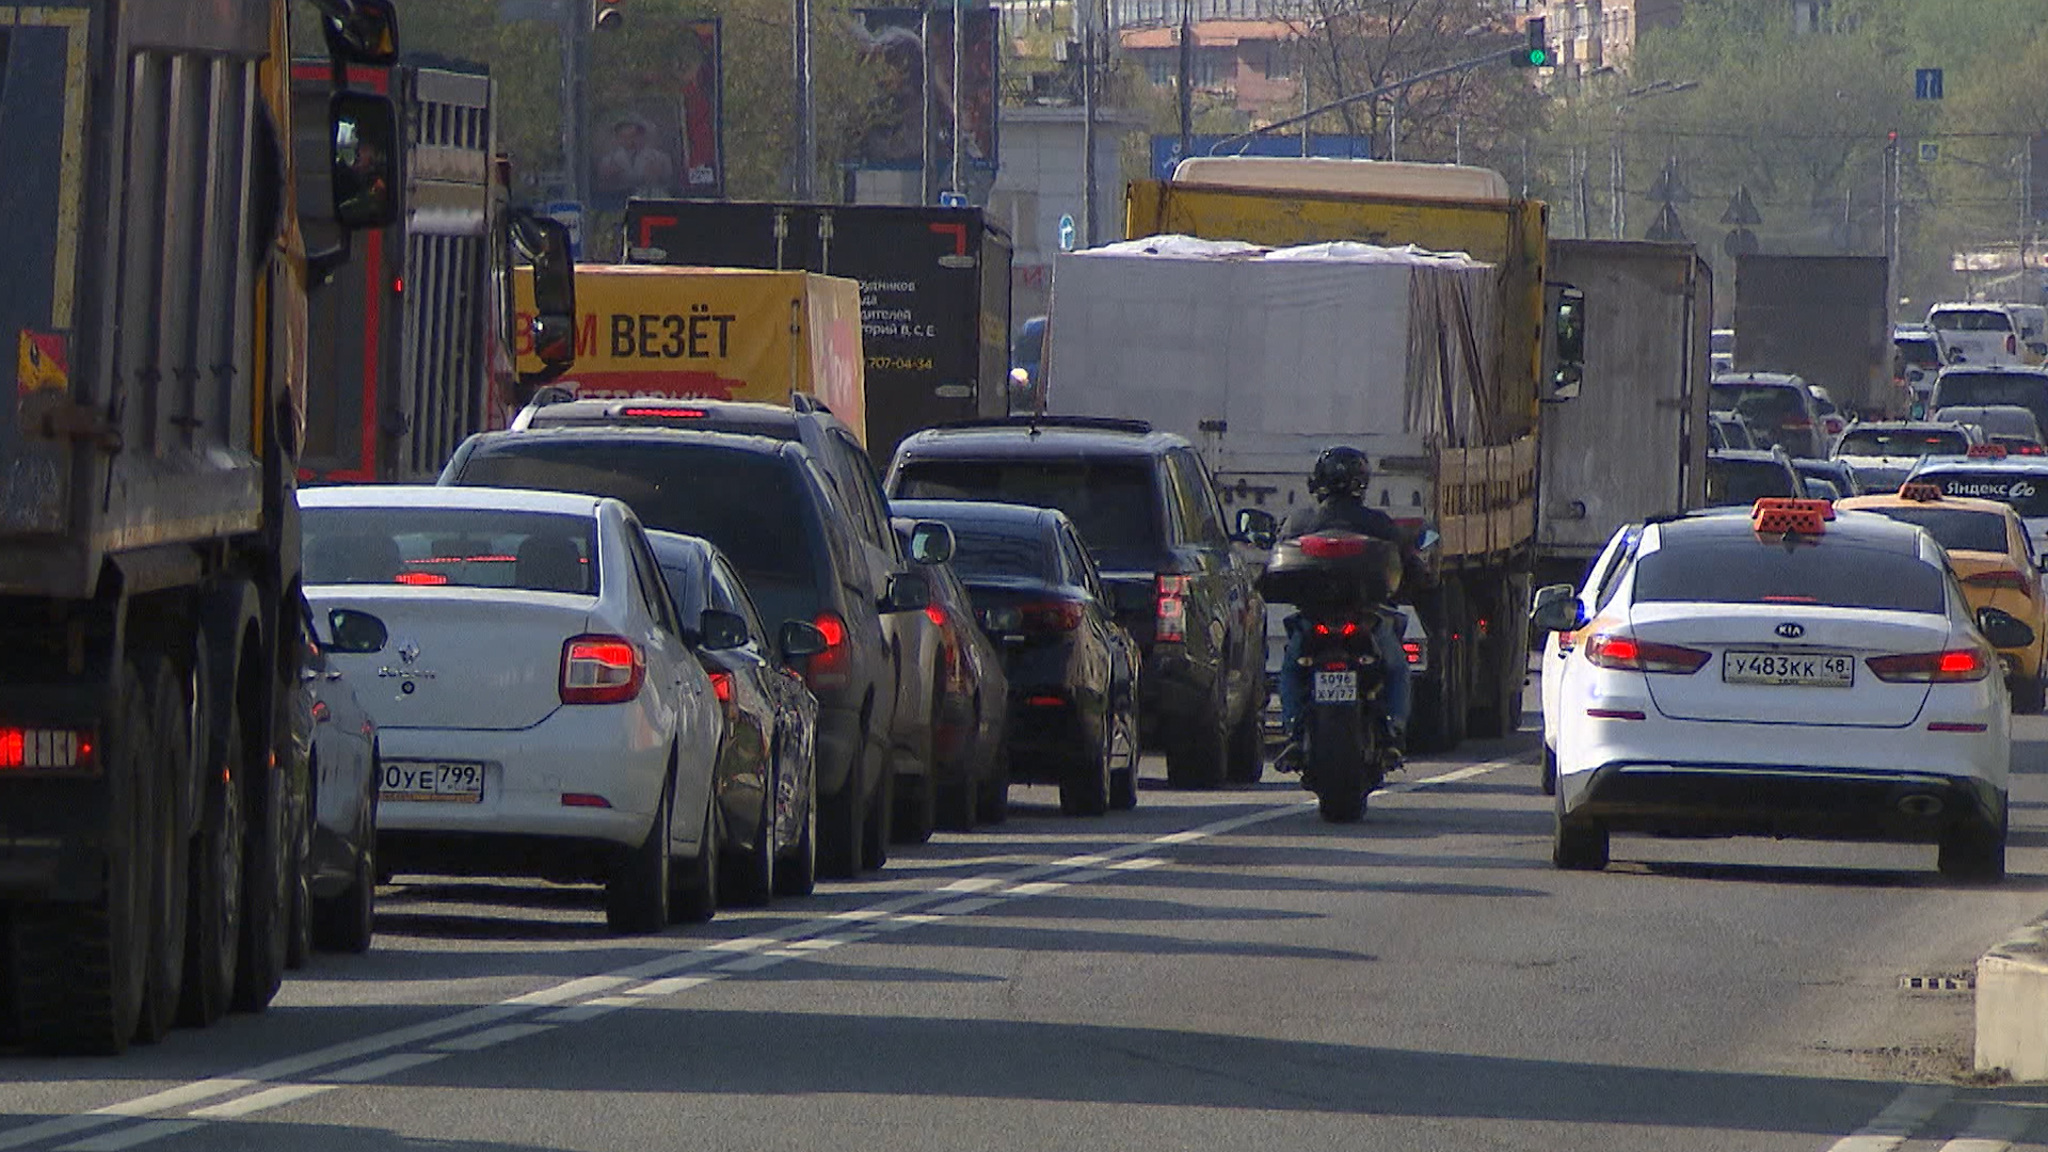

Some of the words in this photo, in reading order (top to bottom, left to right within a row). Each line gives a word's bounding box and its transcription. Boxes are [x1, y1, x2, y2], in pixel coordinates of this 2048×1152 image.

[515, 312, 597, 357] ВМ
[610, 303, 736, 358] ВЕЗЁТ
[1946, 482, 2008, 496] Яндекс
[1778, 626, 1801, 635] KIA
[1825, 659, 1845, 673] 48
[379, 765, 433, 790] 0УЕ
[438, 766, 475, 786] 799
